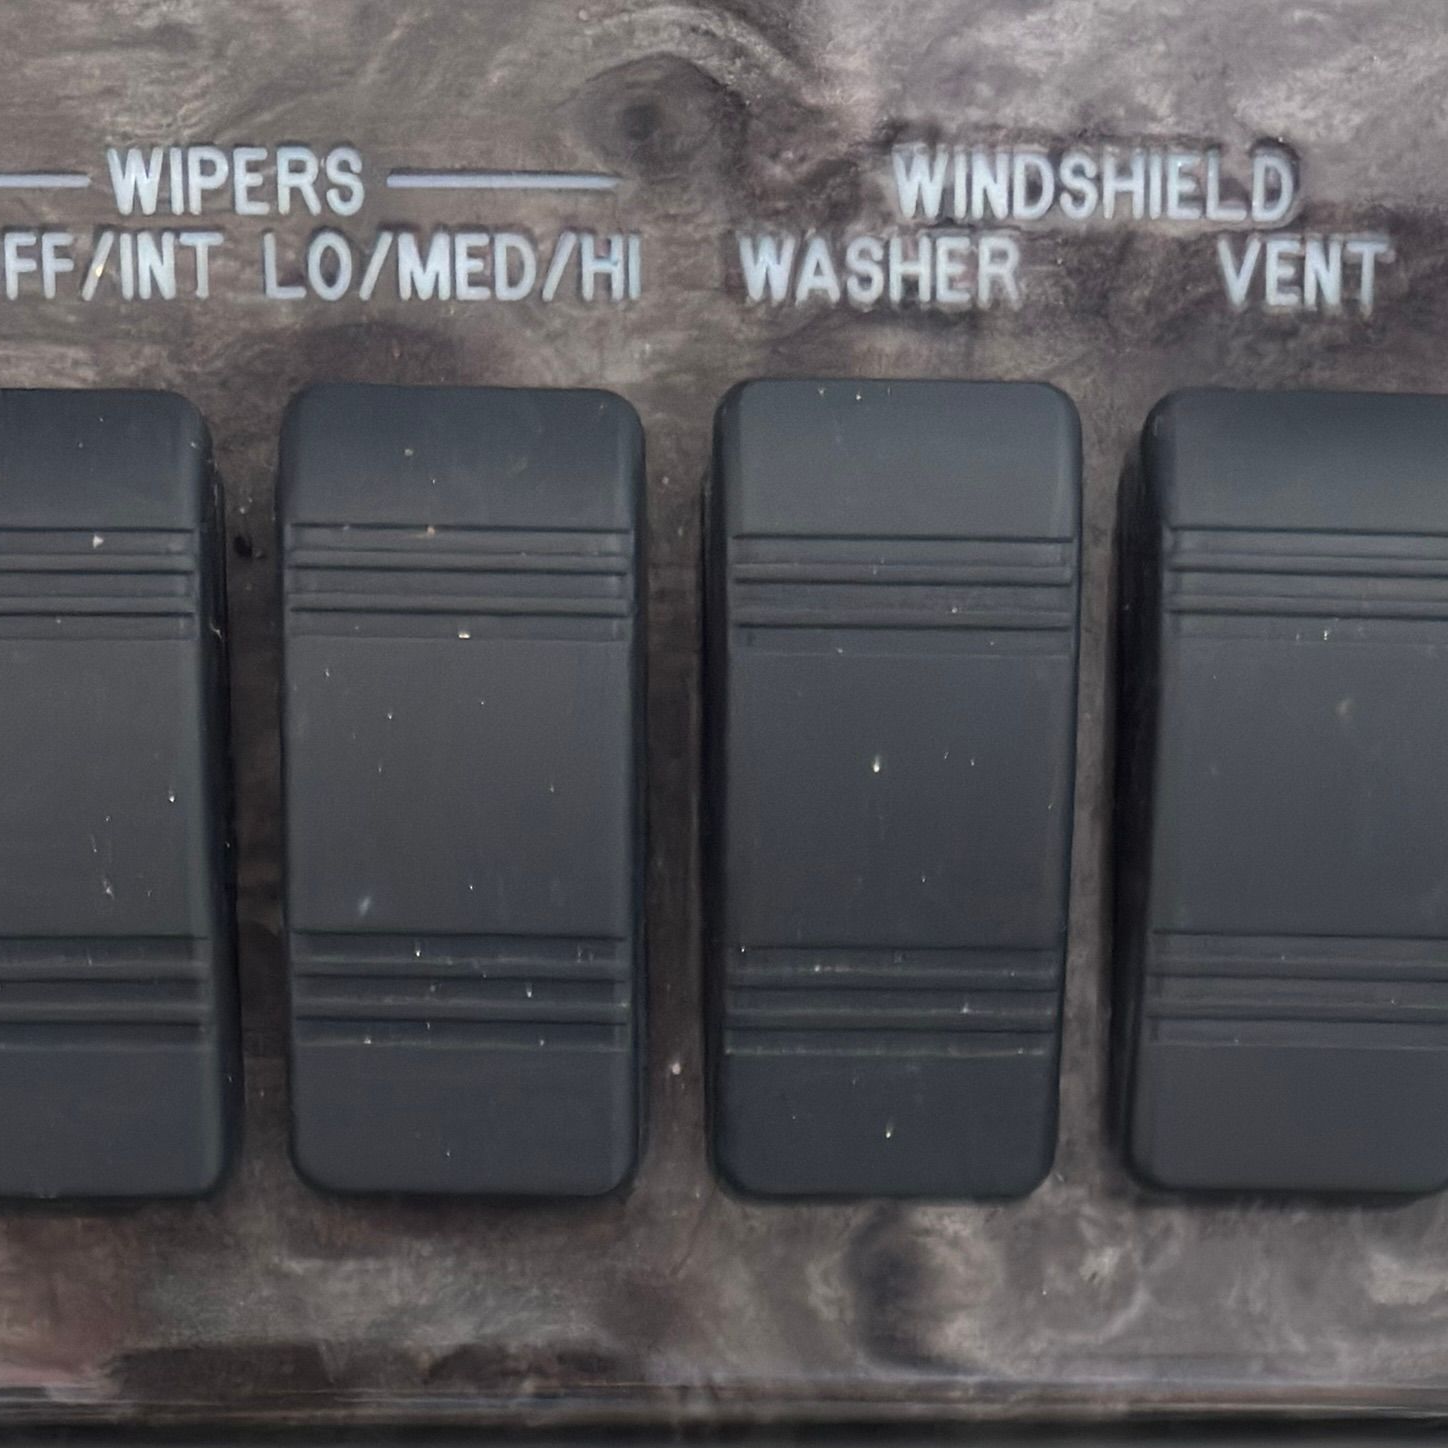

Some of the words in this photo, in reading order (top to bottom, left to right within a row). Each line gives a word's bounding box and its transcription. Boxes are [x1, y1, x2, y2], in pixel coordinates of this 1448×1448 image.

[106, 146, 367, 216] WIPERS
[889, 142, 1297, 224] WINDSHIELD
[262, 232, 644, 303] LO/MED/HI
[736, 232, 1020, 308] WASHER
[1217, 236, 1394, 308] VENT
